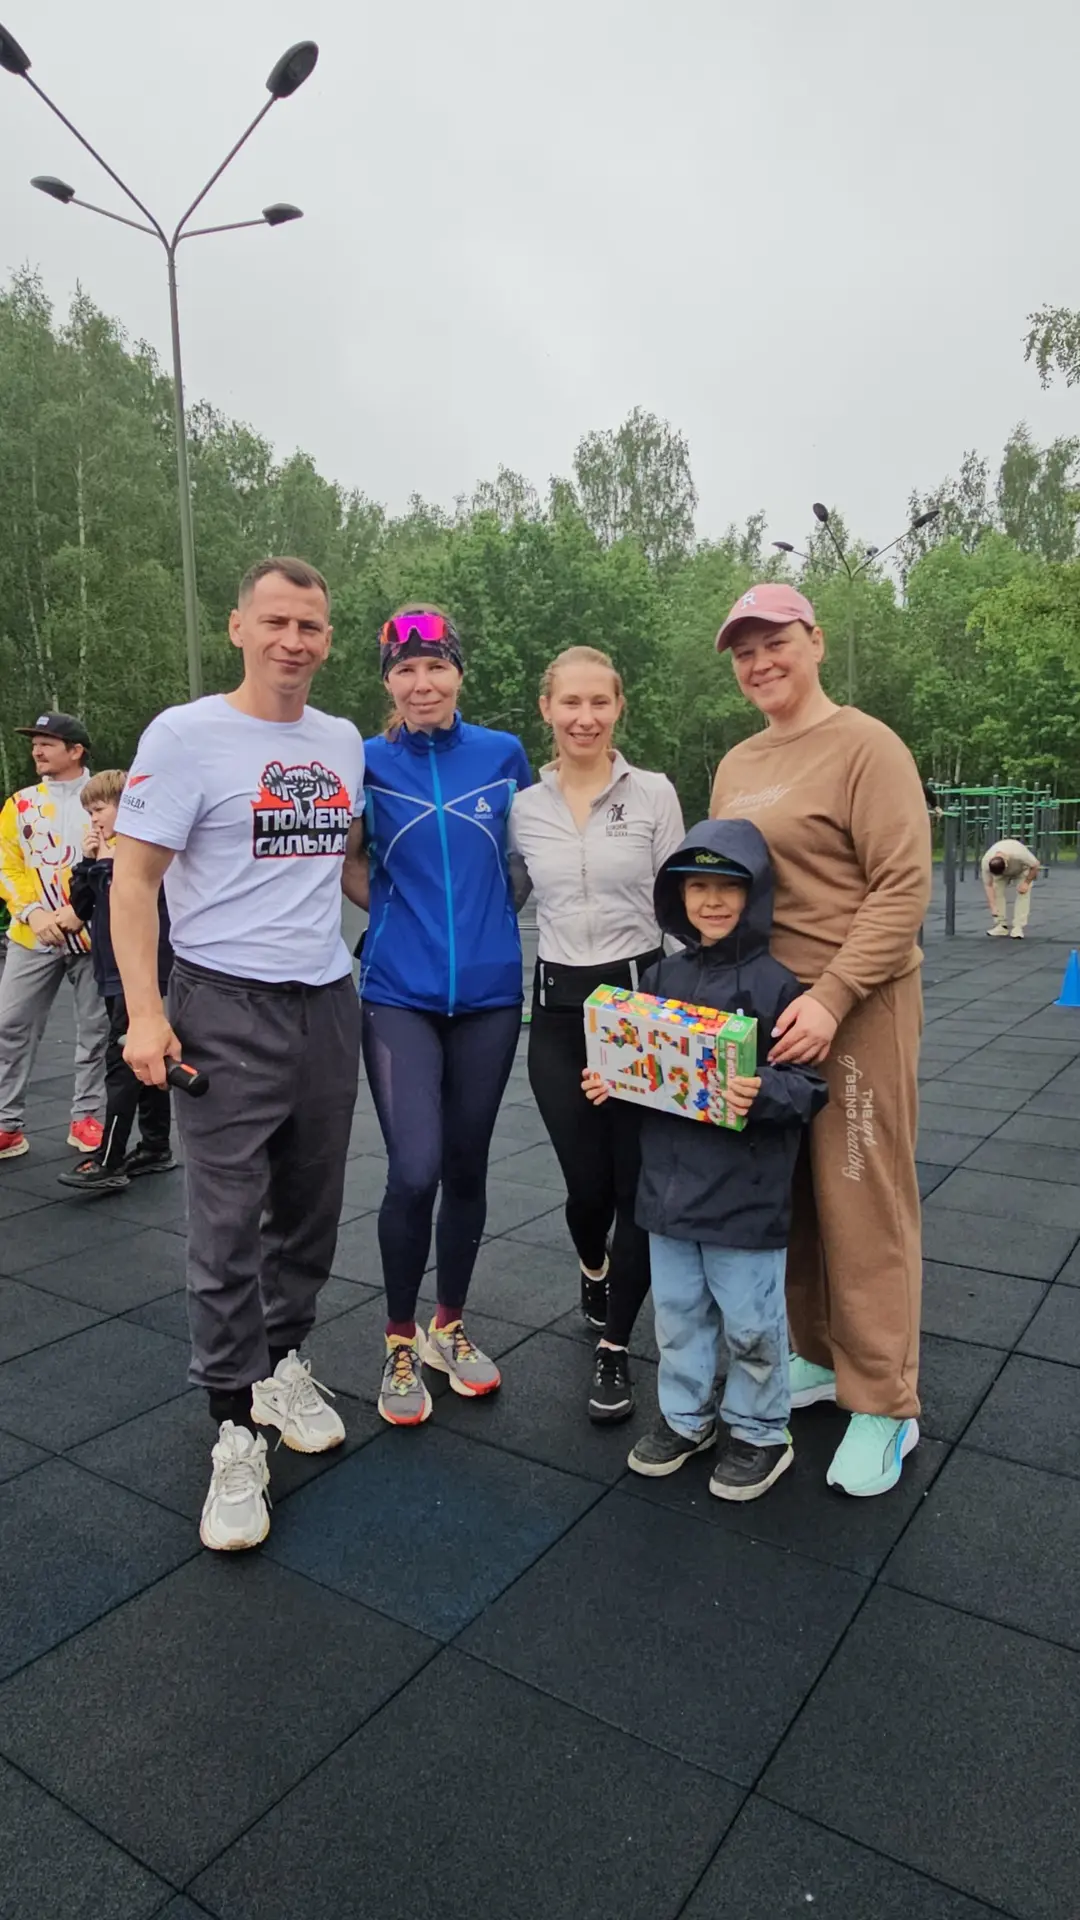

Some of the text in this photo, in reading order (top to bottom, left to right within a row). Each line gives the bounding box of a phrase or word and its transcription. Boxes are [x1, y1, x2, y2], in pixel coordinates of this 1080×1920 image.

[256, 807, 352, 831] ТЮМЕНЬ
[837, 1054, 865, 1182] of BEING healthy
[862, 1088, 878, 1147] THE art
